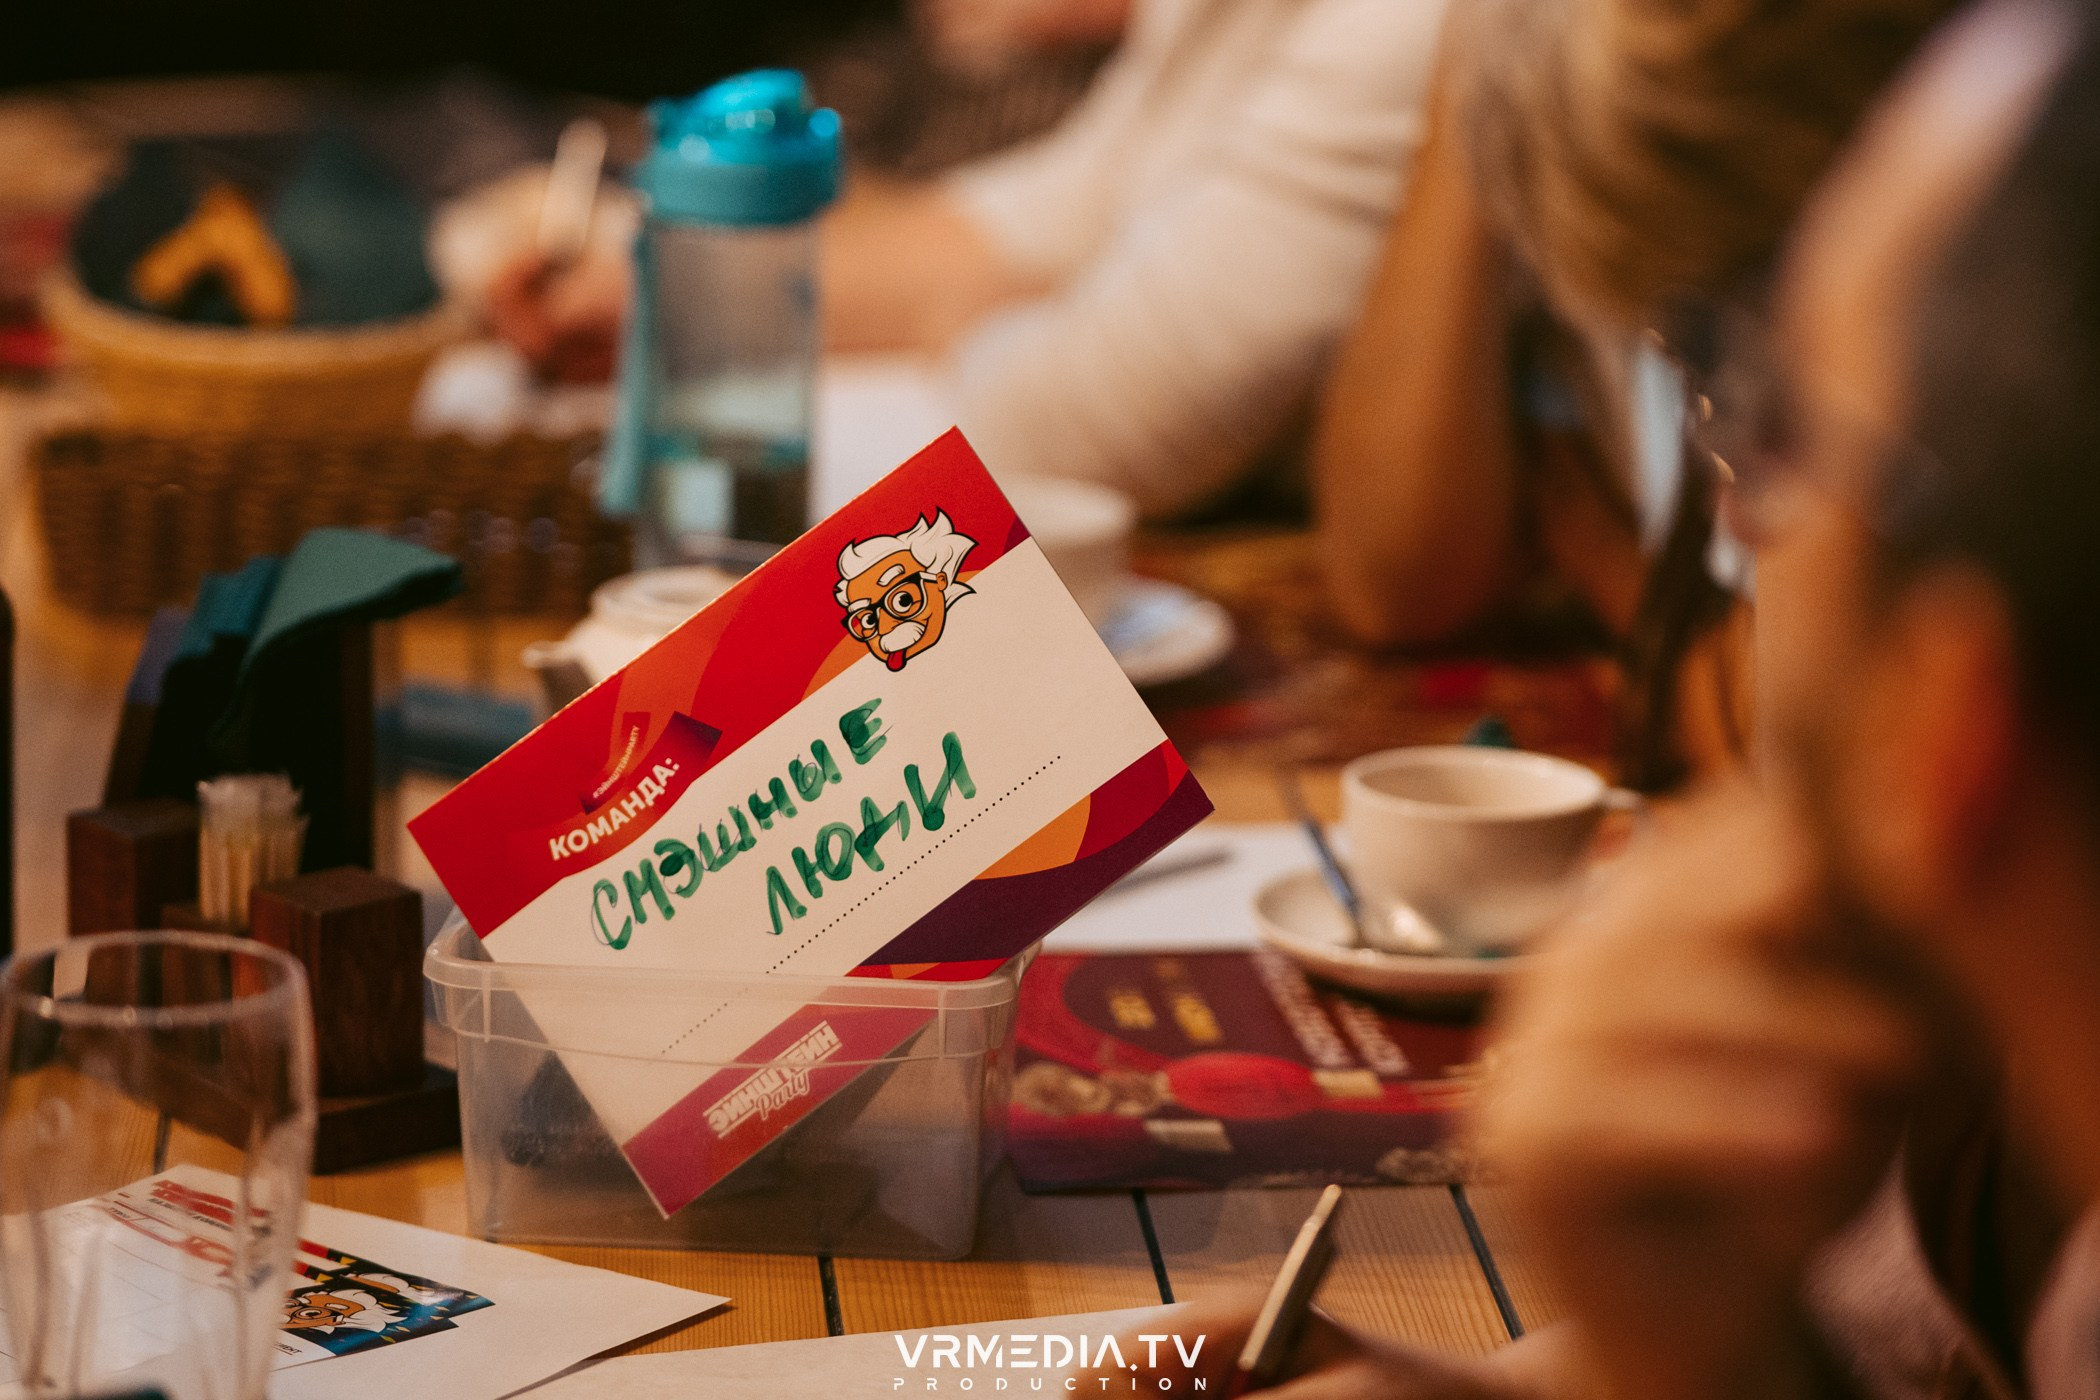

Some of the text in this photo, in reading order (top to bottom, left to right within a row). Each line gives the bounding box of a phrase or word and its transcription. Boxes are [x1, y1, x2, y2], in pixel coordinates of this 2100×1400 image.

[549, 757, 680, 861] КОМАНДА:
[767, 731, 976, 935] ЛЮДИ
[755, 1069, 810, 1121] Party
